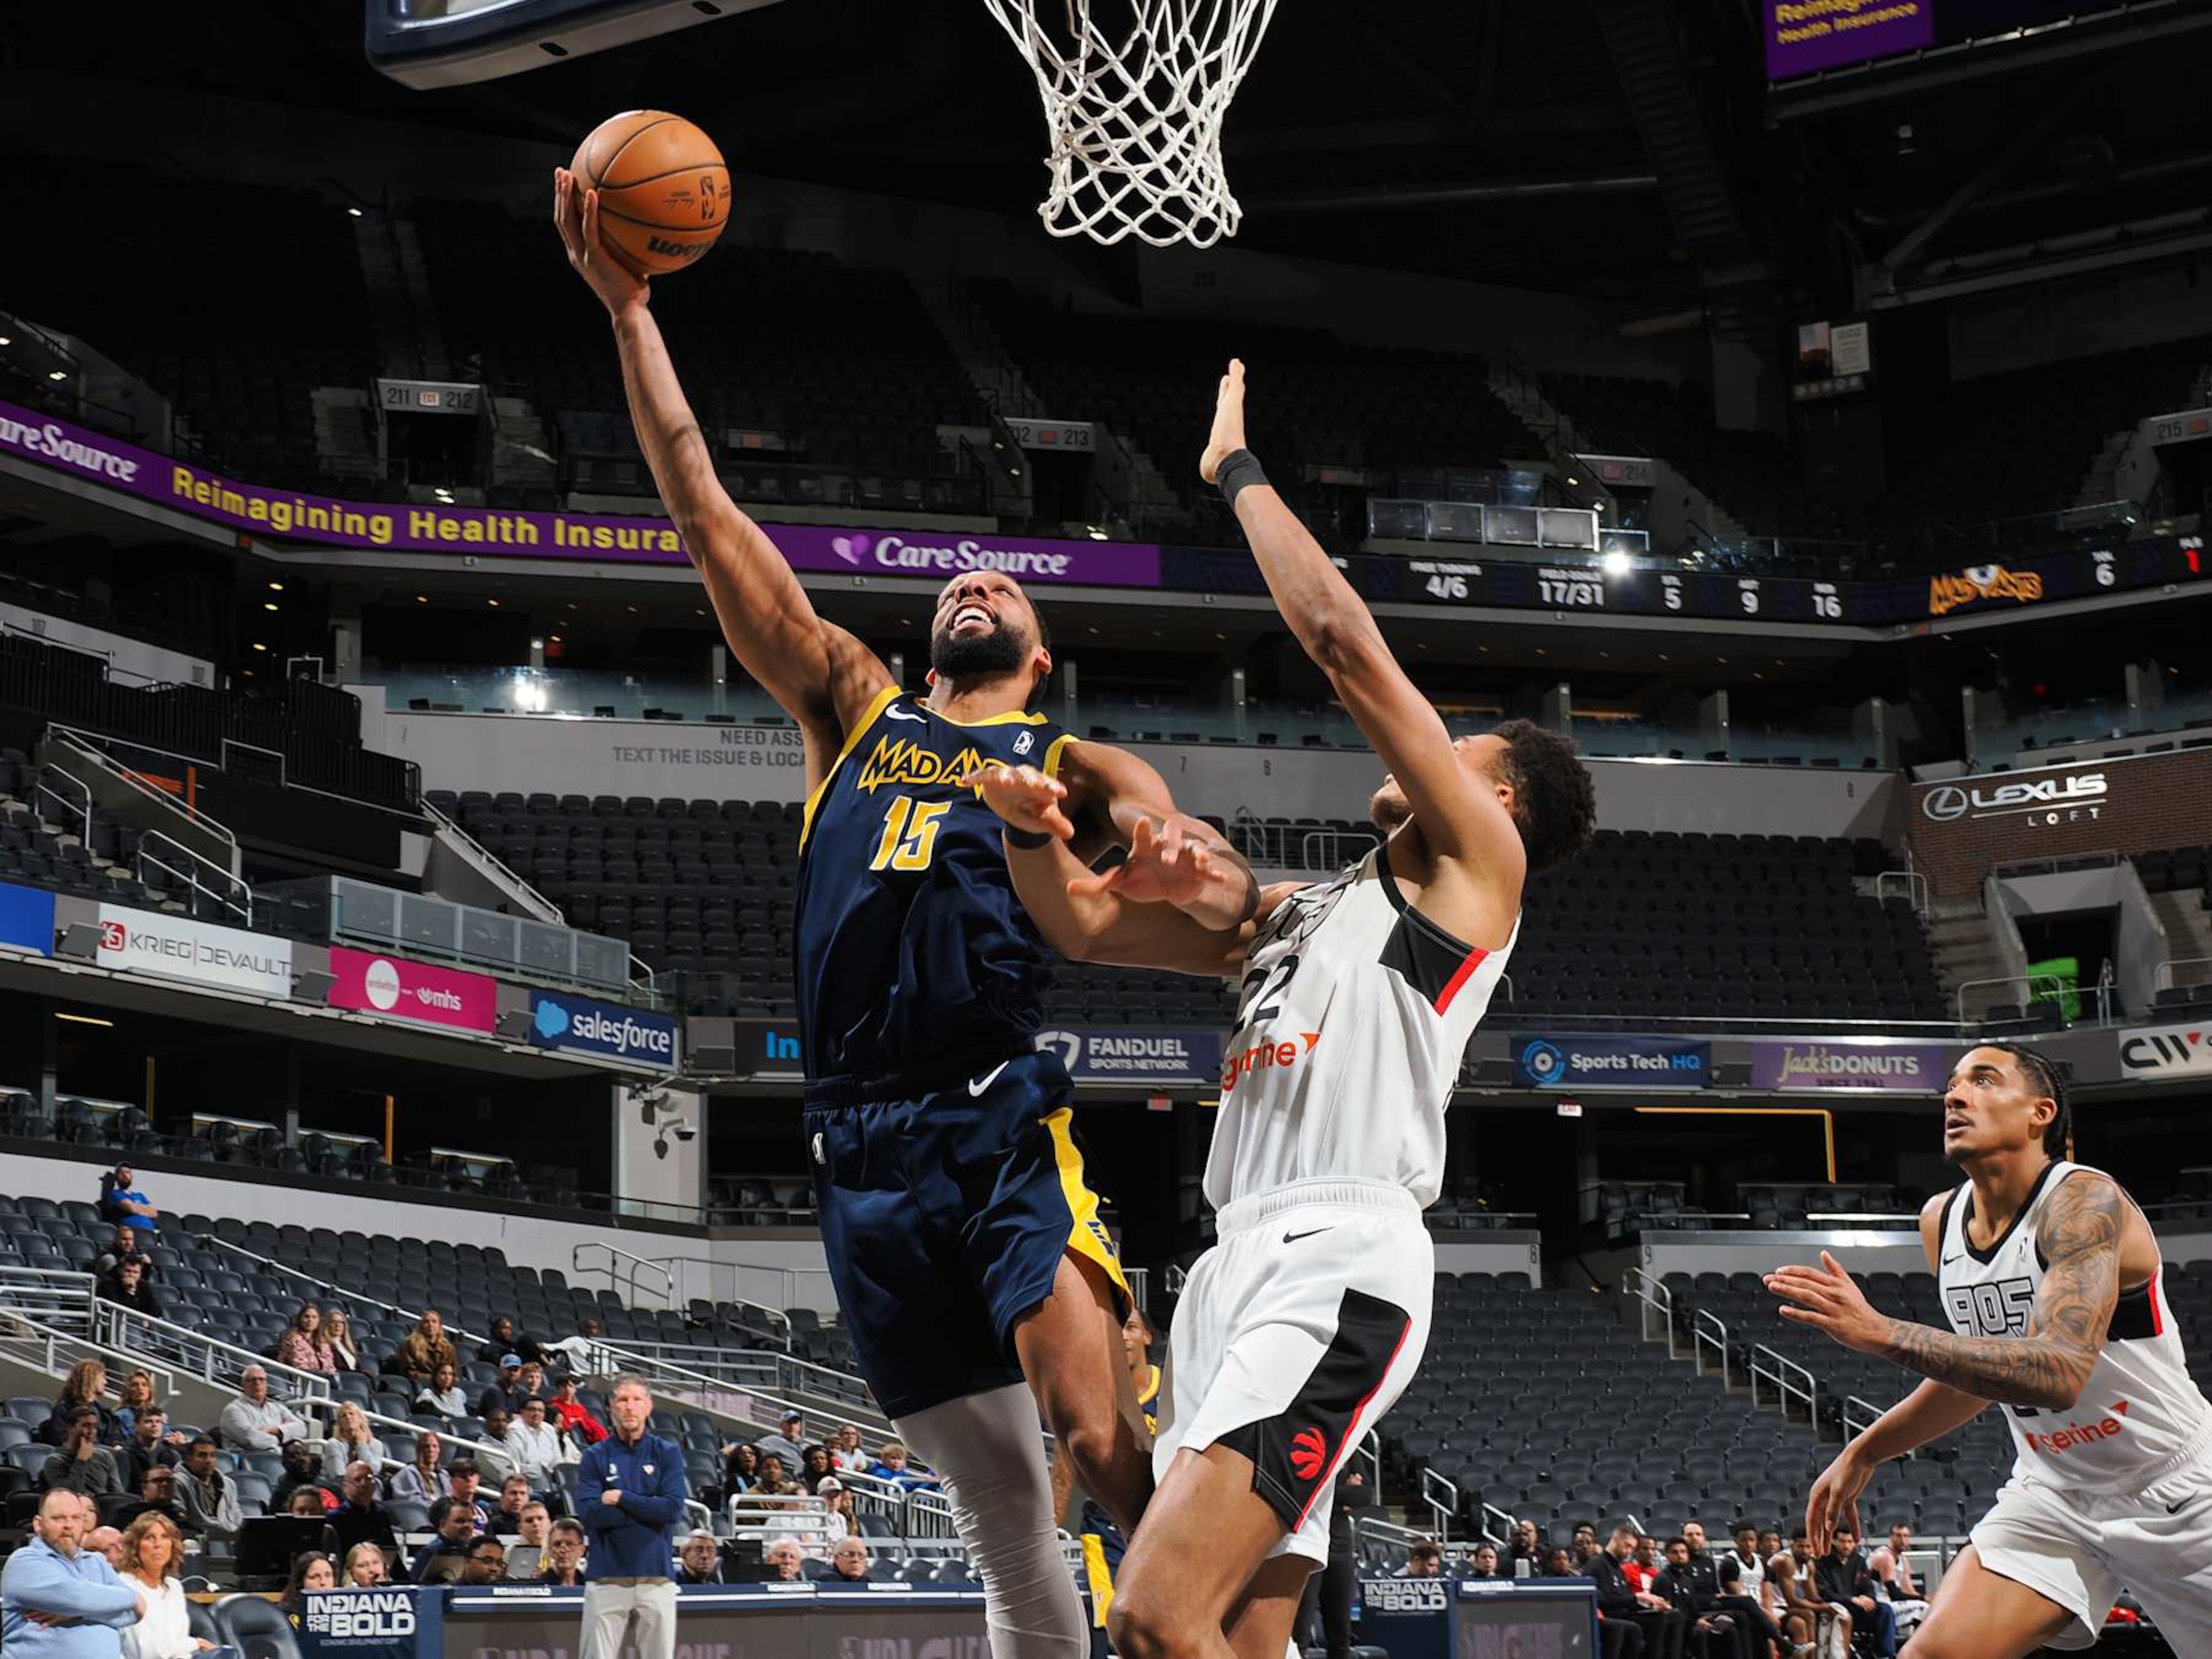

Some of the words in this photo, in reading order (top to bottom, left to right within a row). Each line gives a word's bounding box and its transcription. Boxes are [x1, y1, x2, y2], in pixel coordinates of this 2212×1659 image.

[1777, 22, 1831, 44] Health
[1834, 3, 1918, 31] Insurance
[387, 388, 410, 404] 211
[445, 392, 472, 409] 212
[1065, 430, 1088, 445] 213
[2158, 422, 2181, 439] 215
[0, 417, 137, 483] areSource
[174, 466, 393, 544] Reimagining
[409, 510, 539, 544] Health
[555, 519, 682, 552] Insura
[875, 536, 1069, 575] CareSource
[2183, 550, 2200, 573] 1
[2096, 563, 2115, 586] 6
[1426, 575, 1468, 599] 4/6
[1538, 581, 1604, 605] 17/31
[1665, 587, 1681, 610] 5
[1741, 591, 1758, 613] 9
[1812, 595, 1842, 618] 16
[720, 730, 766, 746] NEED
[771, 731, 804, 747] ASS
[613, 747, 656, 762] TEXT
[658, 748, 690, 764] THE
[696, 749, 746, 766] ISSUE
[751, 751, 763, 766] &
[767, 752, 805, 767] LOCA
[858, 734, 942, 795] MAD
[1971, 773, 2108, 807] LEXUS
[2028, 807, 2100, 827] LOFT
[869, 794, 953, 871] 15
[130, 933, 192, 959] KRIEG
[199, 945, 291, 977] DEVAULT
[433, 990, 462, 1011] mhs
[1232, 955, 1299, 1037] 22
[572, 1011, 669, 1053] salesforce
[1089, 1037, 1190, 1056] FANDUEL
[1089, 1058, 1132, 1070] SPORTS
[1134, 1059, 1190, 1070] NETWORK
[1571, 1053, 1628, 1072] Sports
[1629, 1054, 1669, 1070] Tech
[1672, 1054, 1702, 1070] HQ
[1777, 1045, 1830, 1077] Jack's
[1830, 1055, 1919, 1074] DONUTS
[1530, 1245, 1537, 1263] 8
[1645, 1245, 1651, 1264] 9
[1946, 1276, 2037, 1338] 905
[1365, 1582, 1445, 1596] INDIANA
[307, 1593, 413, 1613] INDIANA
[1382, 1594, 1447, 1611] BOLD
[307, 1614, 330, 1623] FOR
[307, 1623, 330, 1633] THE
[330, 1612, 415, 1637] BOLD
